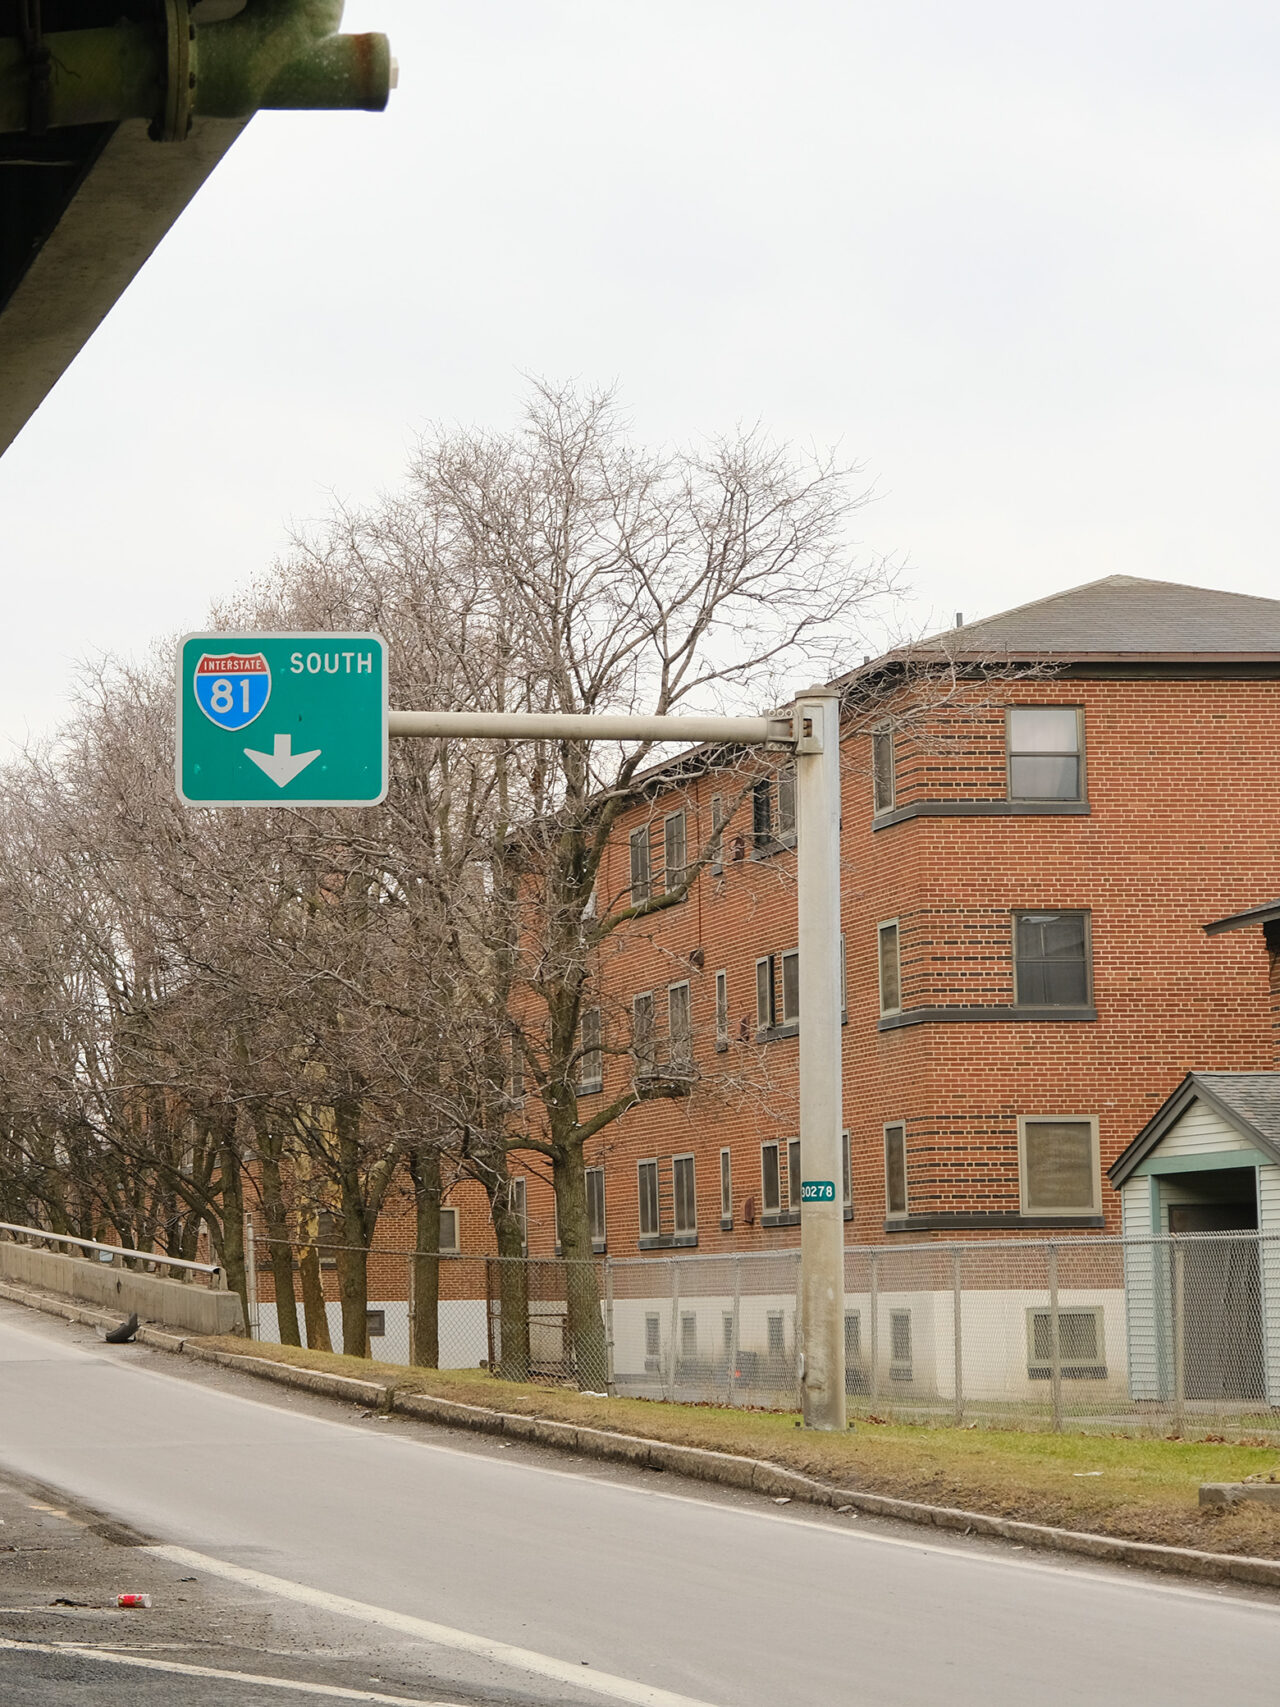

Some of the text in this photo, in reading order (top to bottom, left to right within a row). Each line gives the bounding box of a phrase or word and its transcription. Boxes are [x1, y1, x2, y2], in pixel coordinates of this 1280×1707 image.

[204, 658, 262, 671] INTERSTATE
[290, 652, 372, 674] SOUTH
[210, 678, 250, 714] 81
